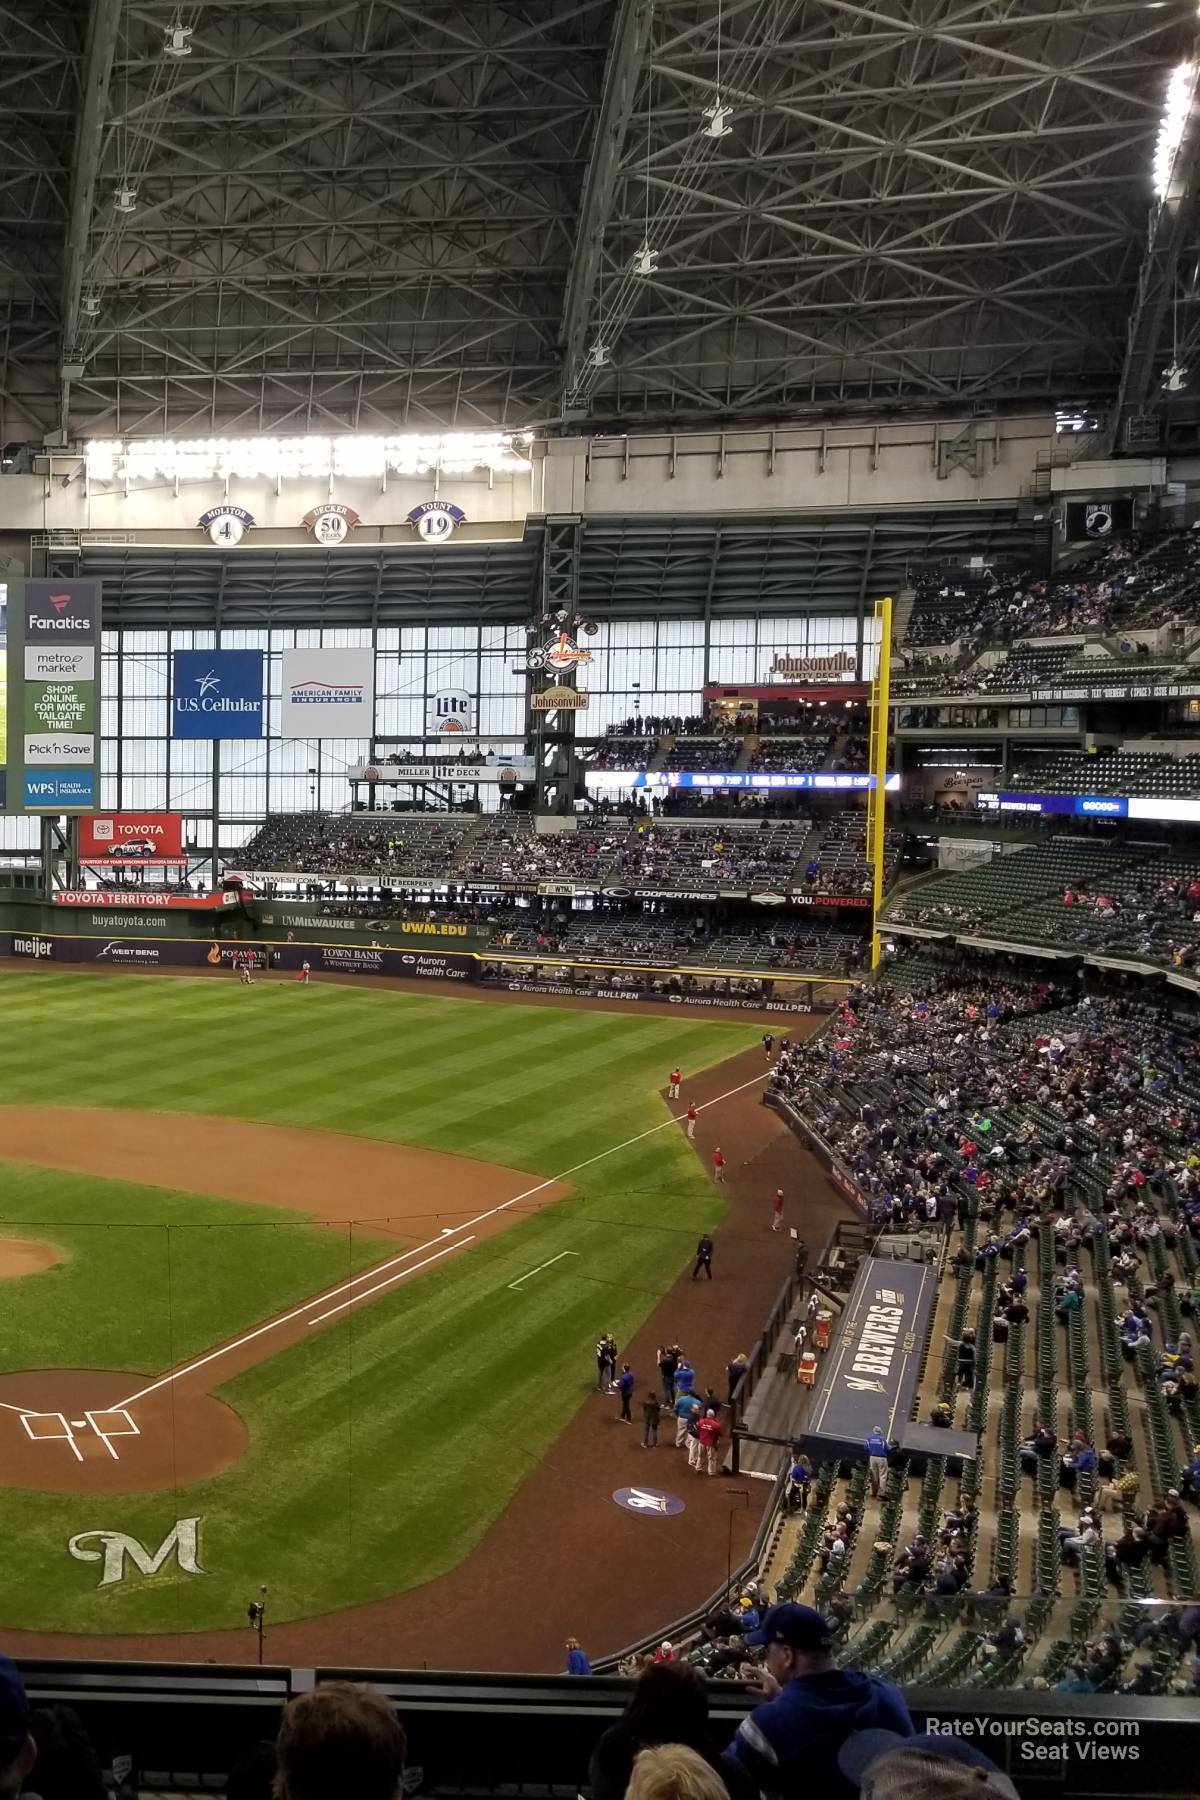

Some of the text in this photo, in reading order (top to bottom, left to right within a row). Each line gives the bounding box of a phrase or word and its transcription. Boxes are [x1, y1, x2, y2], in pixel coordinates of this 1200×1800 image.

[312, 506, 348, 516] UECKER
[420, 502, 452, 512] YOUNT
[208, 508, 247, 520] MOLITOR
[218, 522, 232, 540] 4
[320, 518, 340, 532] 50
[424, 517, 450, 536] 19
[29, 615, 90, 630] Fanatics
[37, 654, 72, 664] metro
[770, 652, 856, 672] Johnsonville
[37, 664, 76, 673] market
[46, 686, 74, 694] SHOP
[42, 694, 78, 702] ONLINE
[532, 694, 587, 708] Johnsonville
[34, 704, 86, 712] FOR MORE
[176, 698, 260, 712] U.S. Cellular
[436, 698, 468, 717] Lite
[38, 712, 82, 720] TAILGATE
[47, 720, 74, 728] TIME!
[29, 744, 90, 754] Pick Save
[398, 766, 480, 780] MILLER Lite DECK
[28, 784, 54, 794] WPS
[118, 826, 164, 834] TOYOTA
[60, 893, 171, 905] TOYOTA TERRITORY
[92, 914, 166, 928] buyatoyota.com
[402, 922, 468, 936] UWM.EDU
[14, 937, 52, 958] meijer
[322, 948, 384, 961] TOWN BANK
[416, 956, 447, 966] Aurora
[416, 966, 466, 978] Health Care
[522, 984, 638, 1000] Aurora Health Care BULLPEN
[684, 995, 812, 1012] Aurora Health Care BULLPEN
[852, 1305, 904, 1376] BREWERS
